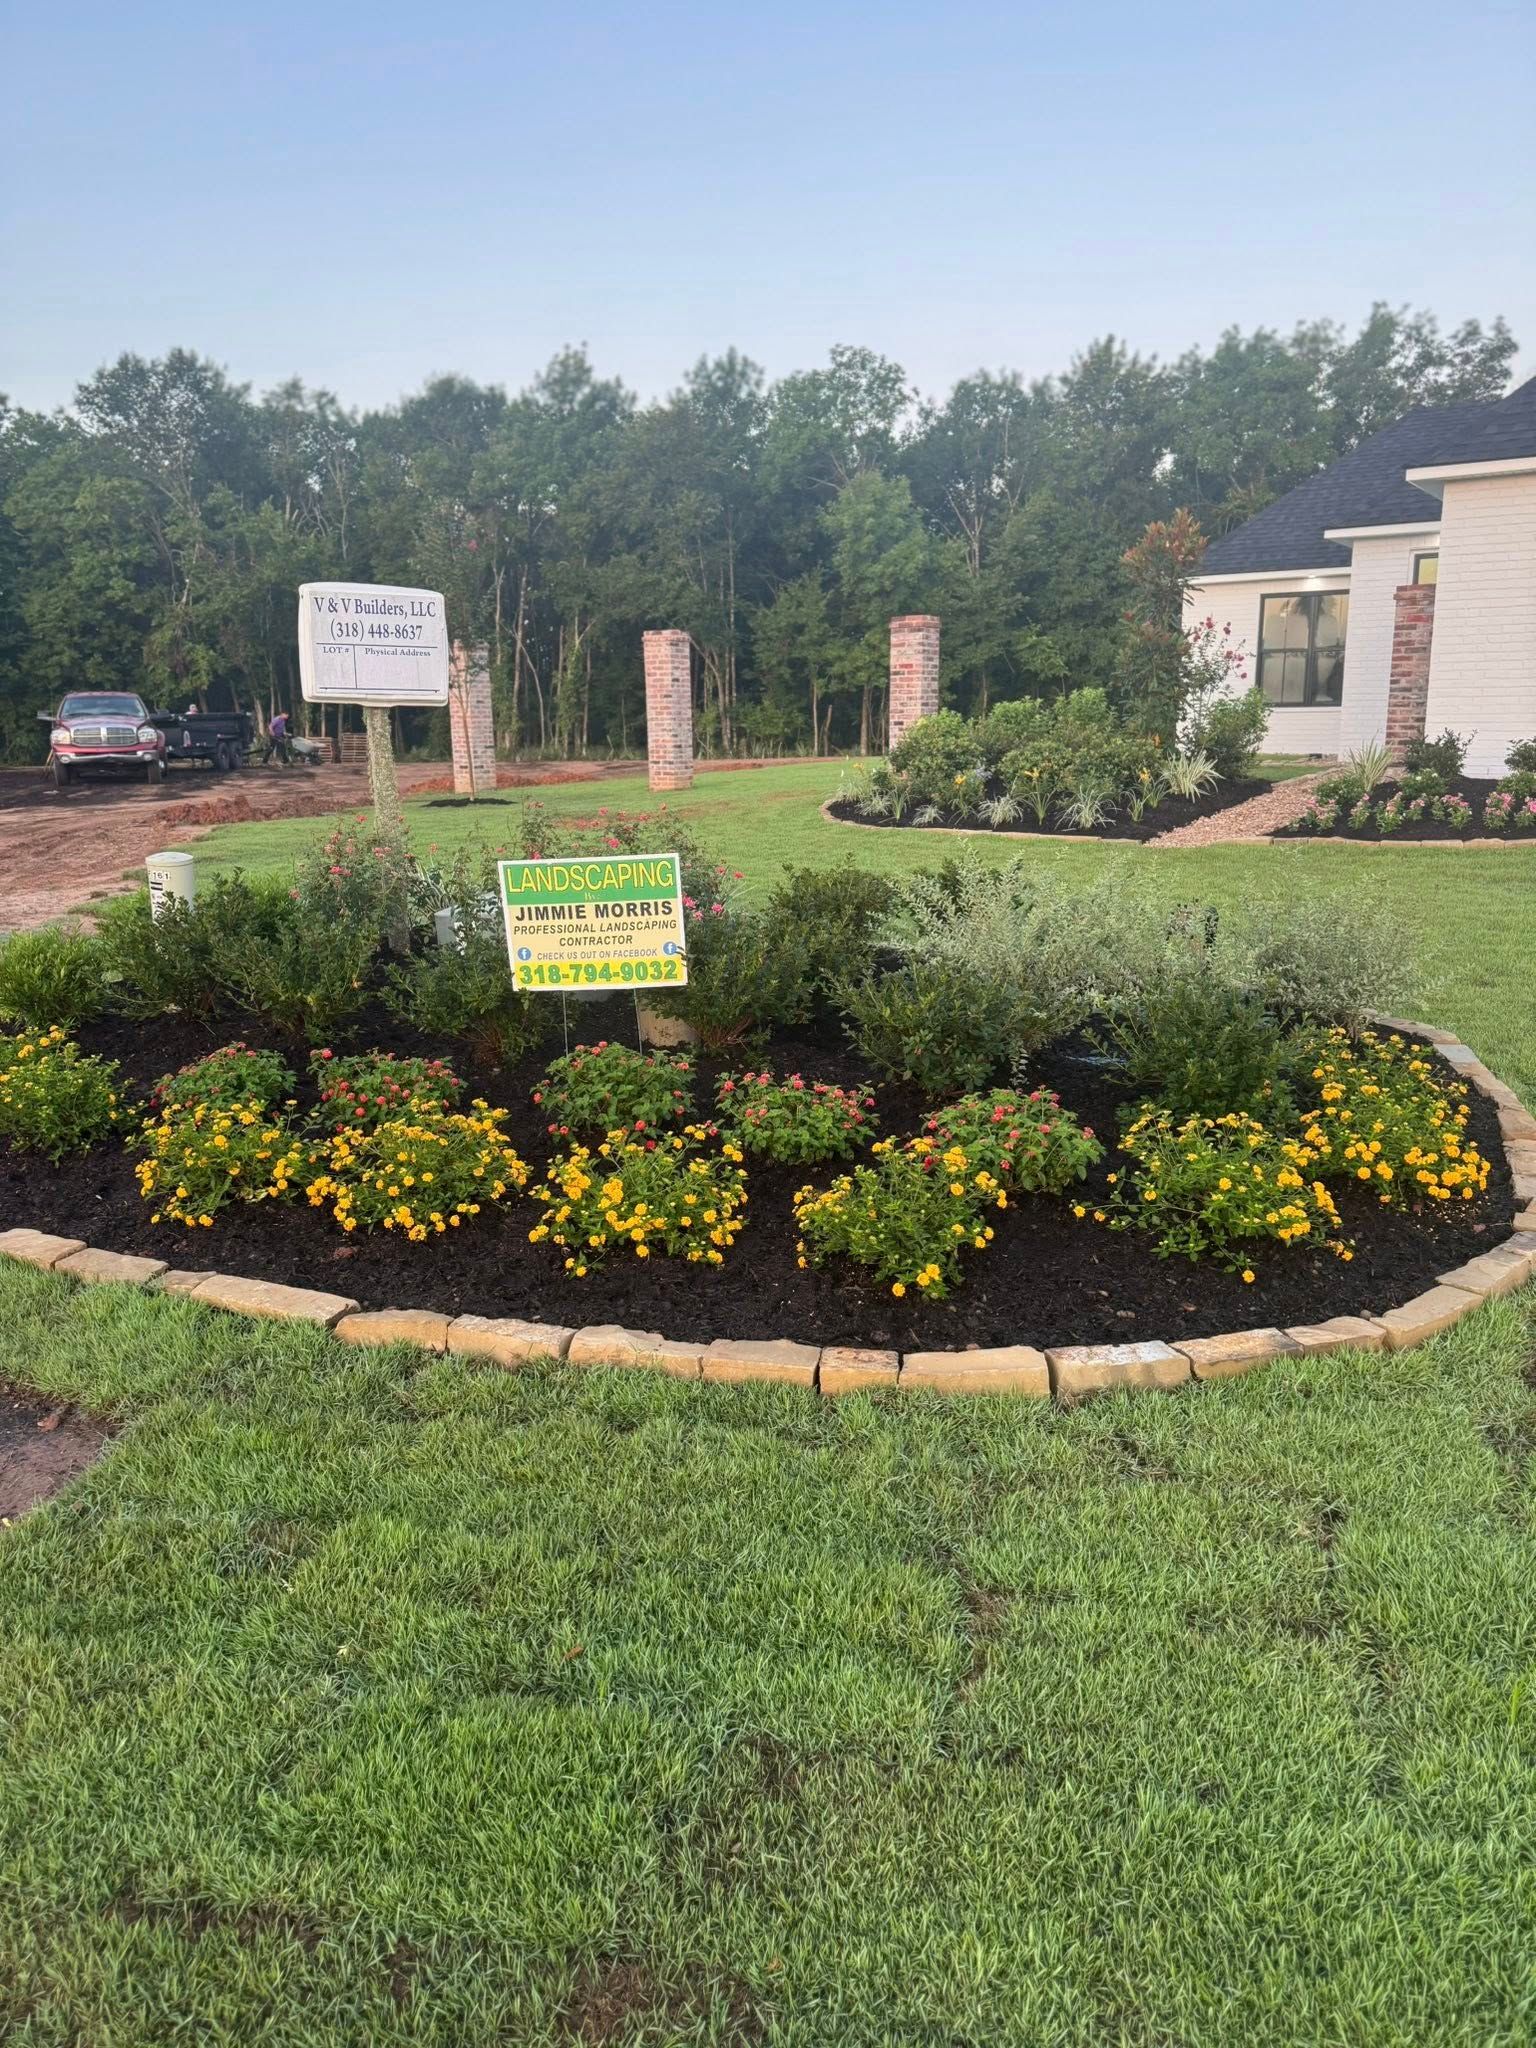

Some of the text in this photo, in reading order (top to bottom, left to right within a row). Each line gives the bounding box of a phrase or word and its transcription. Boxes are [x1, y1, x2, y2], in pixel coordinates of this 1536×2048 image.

[314, 597, 436, 619] V & V Builders, LLC
[331, 619, 422, 641] (318) 448-8637
[365, 648, 397, 656] Physical
[507, 861, 673, 893] LANDSCAPING
[516, 901, 672, 921] JIMMIE MORRIS
[514, 920, 677, 935] PROFESSIONAL LANDSCAPING
[560, 935, 632, 946] CONTRACTOR
[537, 952, 564, 960] CHECK
[613, 949, 657, 958] FACEBOOK
[520, 960, 677, 984] 318-794-9032
